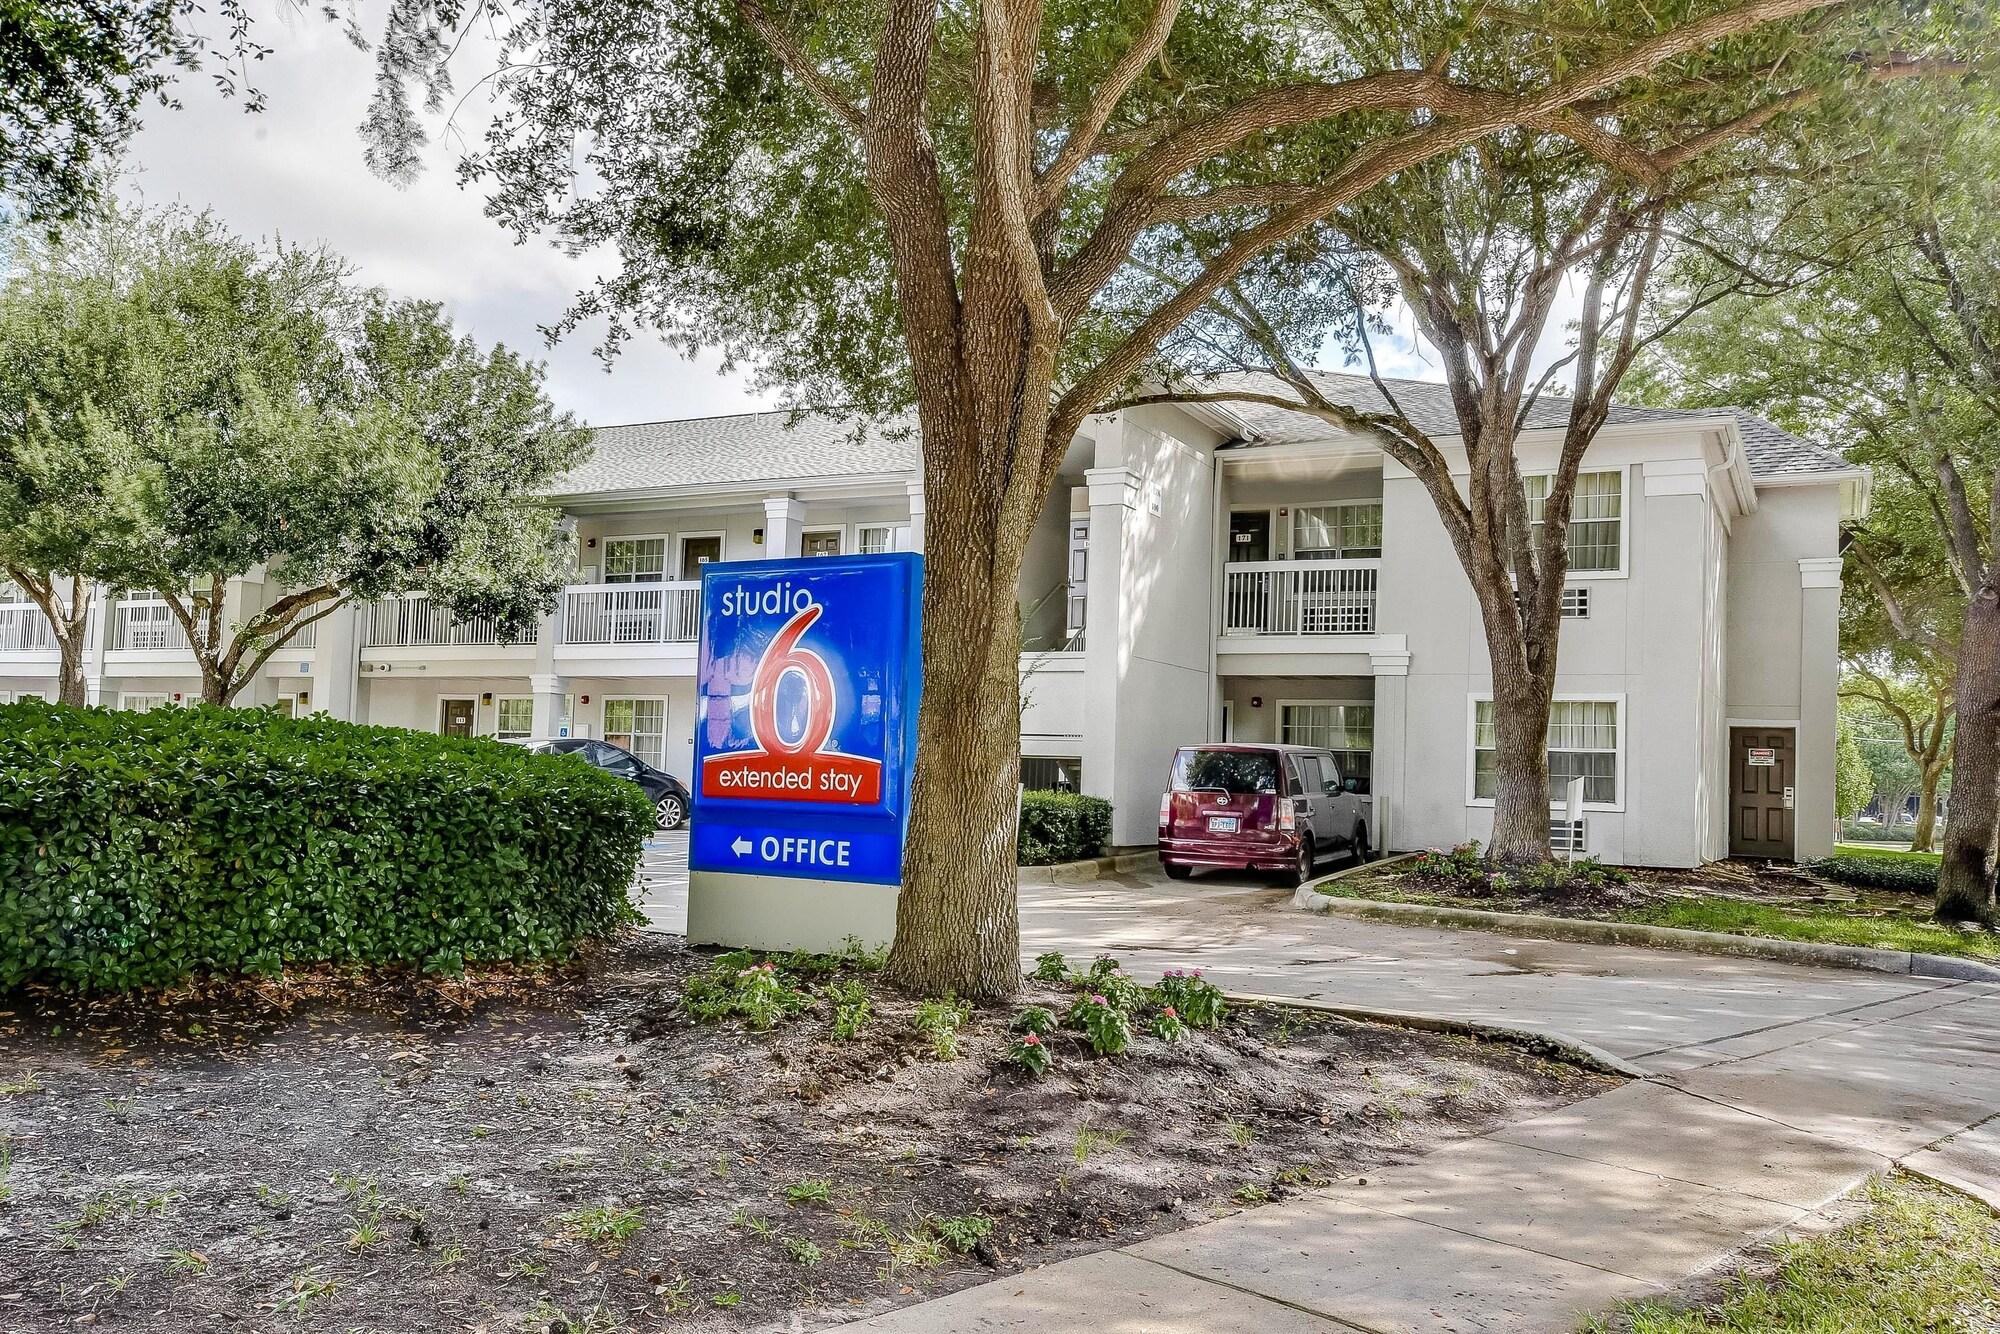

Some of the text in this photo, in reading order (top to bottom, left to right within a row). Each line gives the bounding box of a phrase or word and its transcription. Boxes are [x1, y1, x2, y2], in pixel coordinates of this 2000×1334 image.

[721, 581, 813, 616] studio
[751, 603, 837, 754] 6
[719, 766, 863, 797] extended stay
[761, 836, 850, 867] OFFICE
